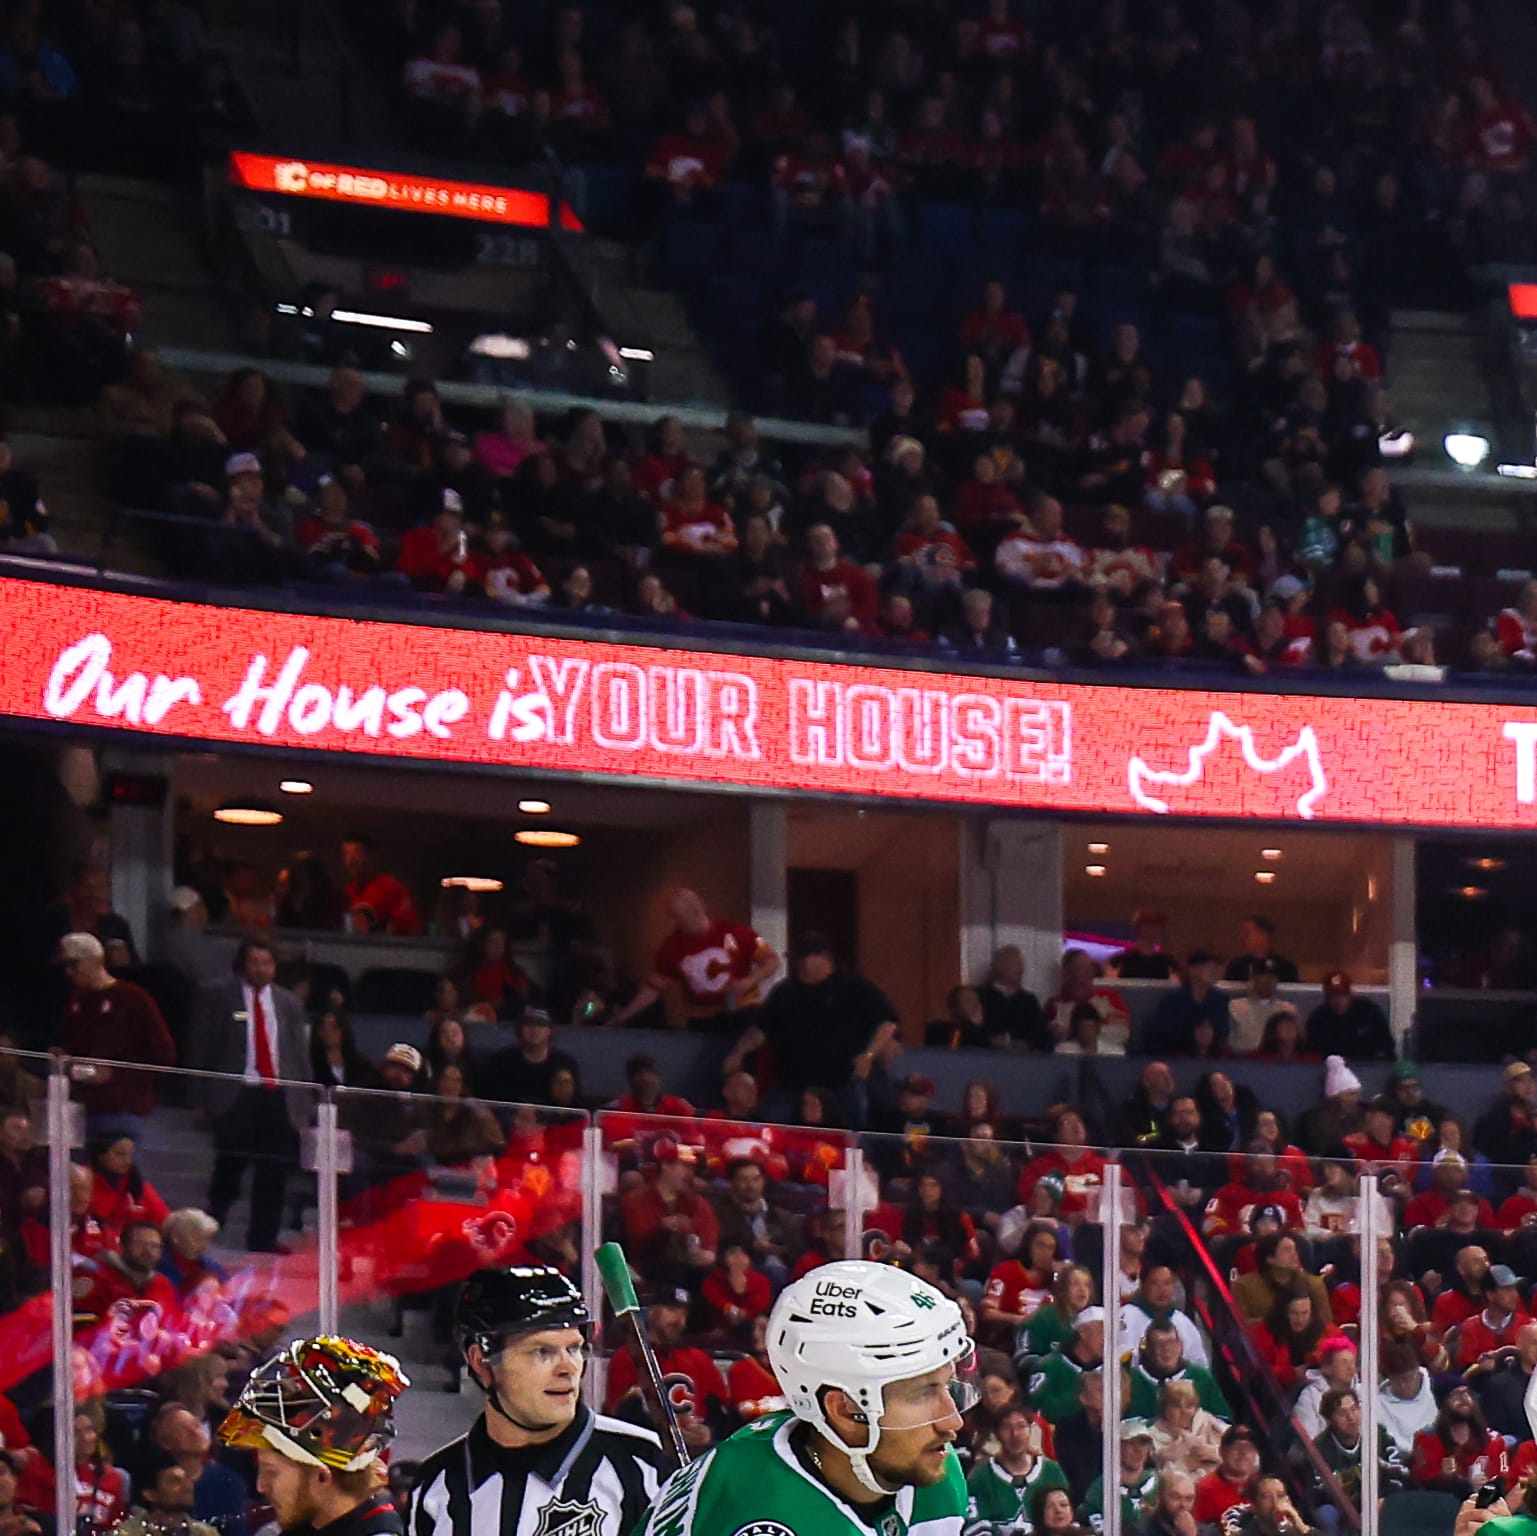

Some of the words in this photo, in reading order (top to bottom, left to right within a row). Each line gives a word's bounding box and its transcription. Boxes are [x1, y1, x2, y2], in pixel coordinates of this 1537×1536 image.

[46, 633, 200, 724] Our
[223, 644, 470, 738] House
[489, 666, 547, 742] is
[528, 655, 760, 764] YOUR
[789, 677, 1074, 787] HOUSE!
[816, 1281, 863, 1299] Uber
[810, 1299, 857, 1318] Eats
